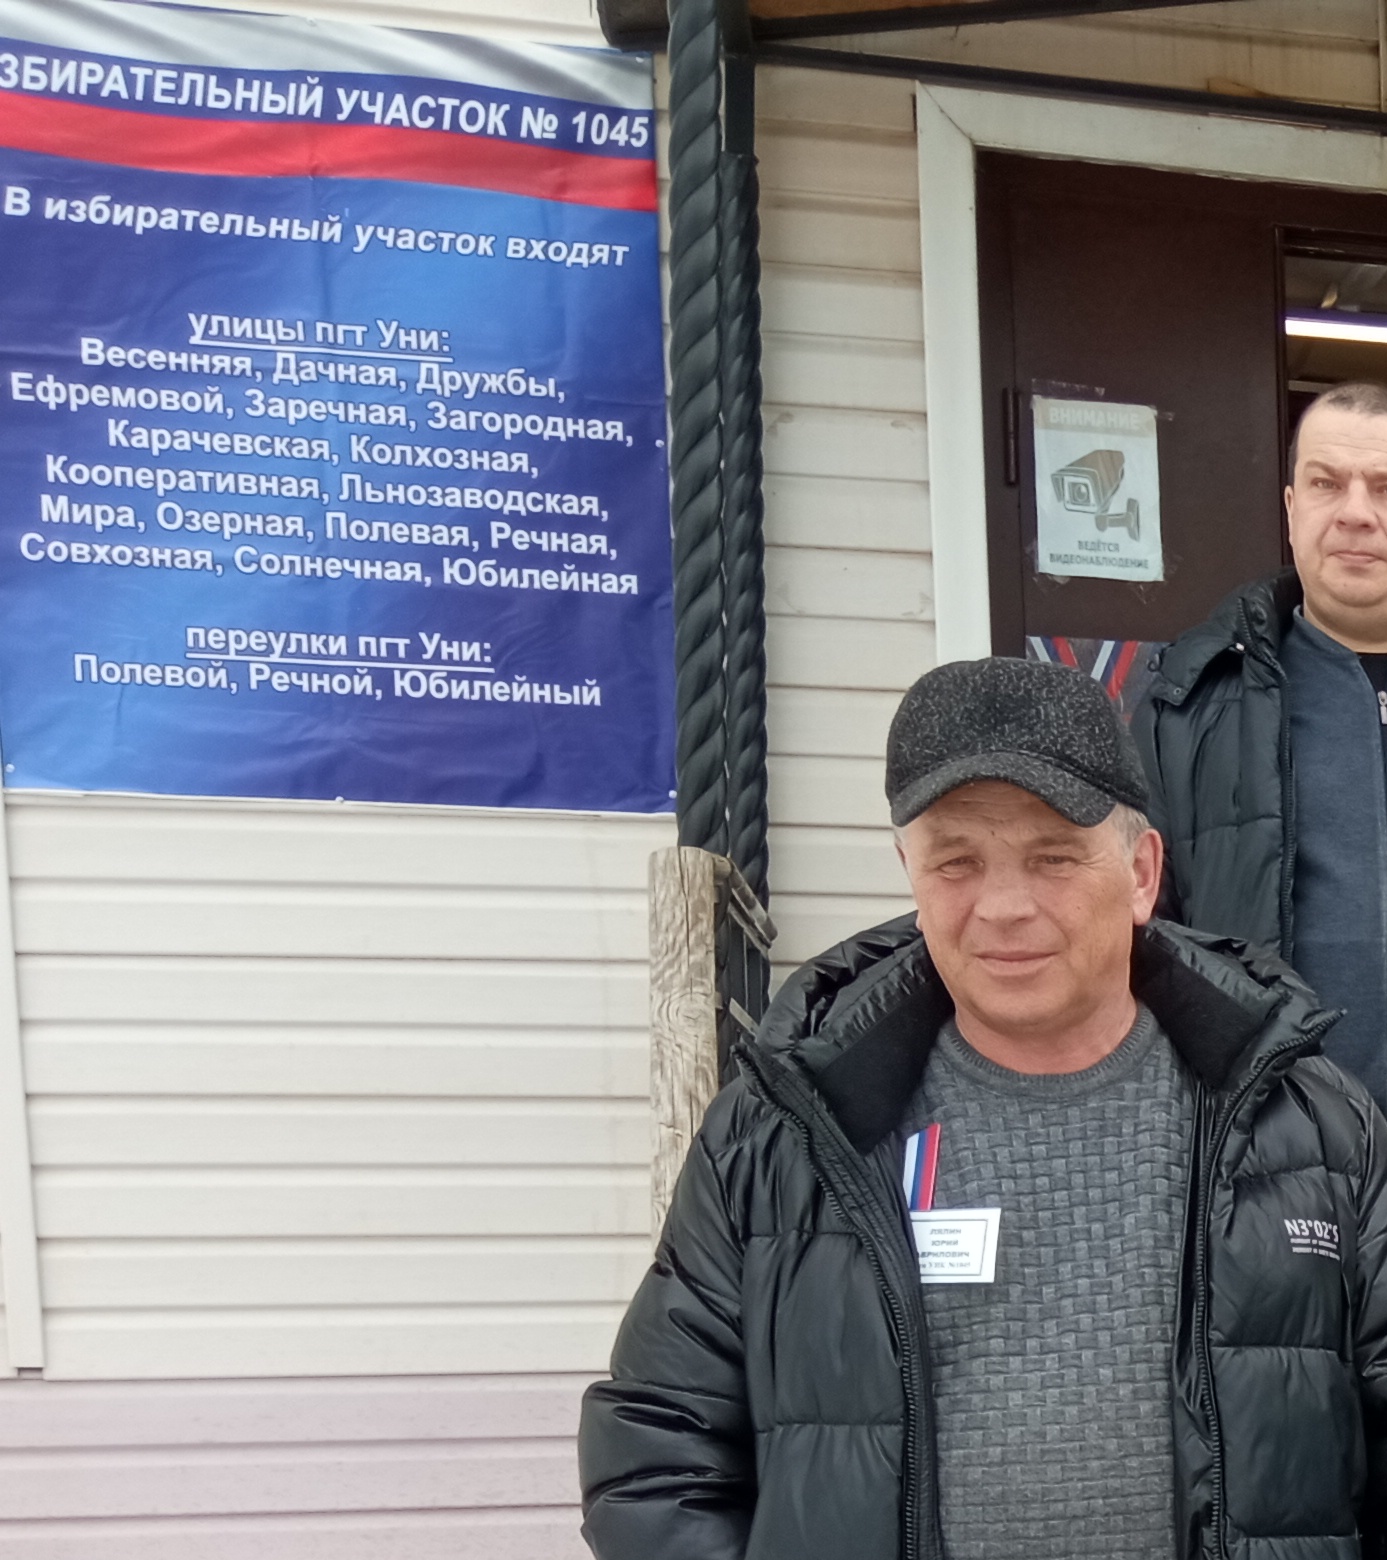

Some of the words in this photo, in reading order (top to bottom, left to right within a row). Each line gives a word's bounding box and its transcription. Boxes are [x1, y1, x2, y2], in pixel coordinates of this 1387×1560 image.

[0, 53, 324, 118] ЗБИРАТЕЛЬНЫЙ
[336, 87, 511, 136] УЧАСТОК
[520, 106, 558, 139] №
[572, 111, 649, 147] 1045
[4, 186, 31, 216] В
[44, 195, 343, 243] избирательный
[353, 224, 496, 256] участок
[506, 237, 630, 268] входят
[188, 313, 305, 344] улицы
[315, 321, 368, 347] пгт
[376, 320, 450, 352] Уни:
[80, 337, 263, 381] Весенняя,
[272, 352, 407, 392] Дачная,
[416, 362, 565, 403] Дружбы,
[10, 371, 235, 420] Ефремовой,
[244, 389, 417, 432] Заречная,
[427, 401, 634, 447] Загородная,
[1050, 406, 1141, 430] ВНИМАНИЕ
[107, 418, 340, 466] Карачевская,
[350, 434, 539, 478] Колхозная,
[46, 454, 330, 505] Кооперативная,
[339, 473, 609, 522] Льнозаводская,
[40, 494, 146, 533] Мира,
[156, 501, 314, 543] Озерная,
[325, 511, 479, 552] Полевая,
[490, 521, 617, 560] Речная,
[20, 532, 224, 577] Совхозная,
[234, 545, 433, 588] Солнечная,
[443, 557, 639, 595] Юбилейная
[1049, 553, 1149, 569] ВИДЕОНАБЛЮДЕНИЕ
[186, 626, 347, 658] переулки
[358, 635, 411, 659] пгт
[418, 632, 492, 663] Уни:
[73, 653, 238, 695] Полевой,
[249, 662, 383, 700] Речной,
[394, 670, 602, 706] Юбилейный
